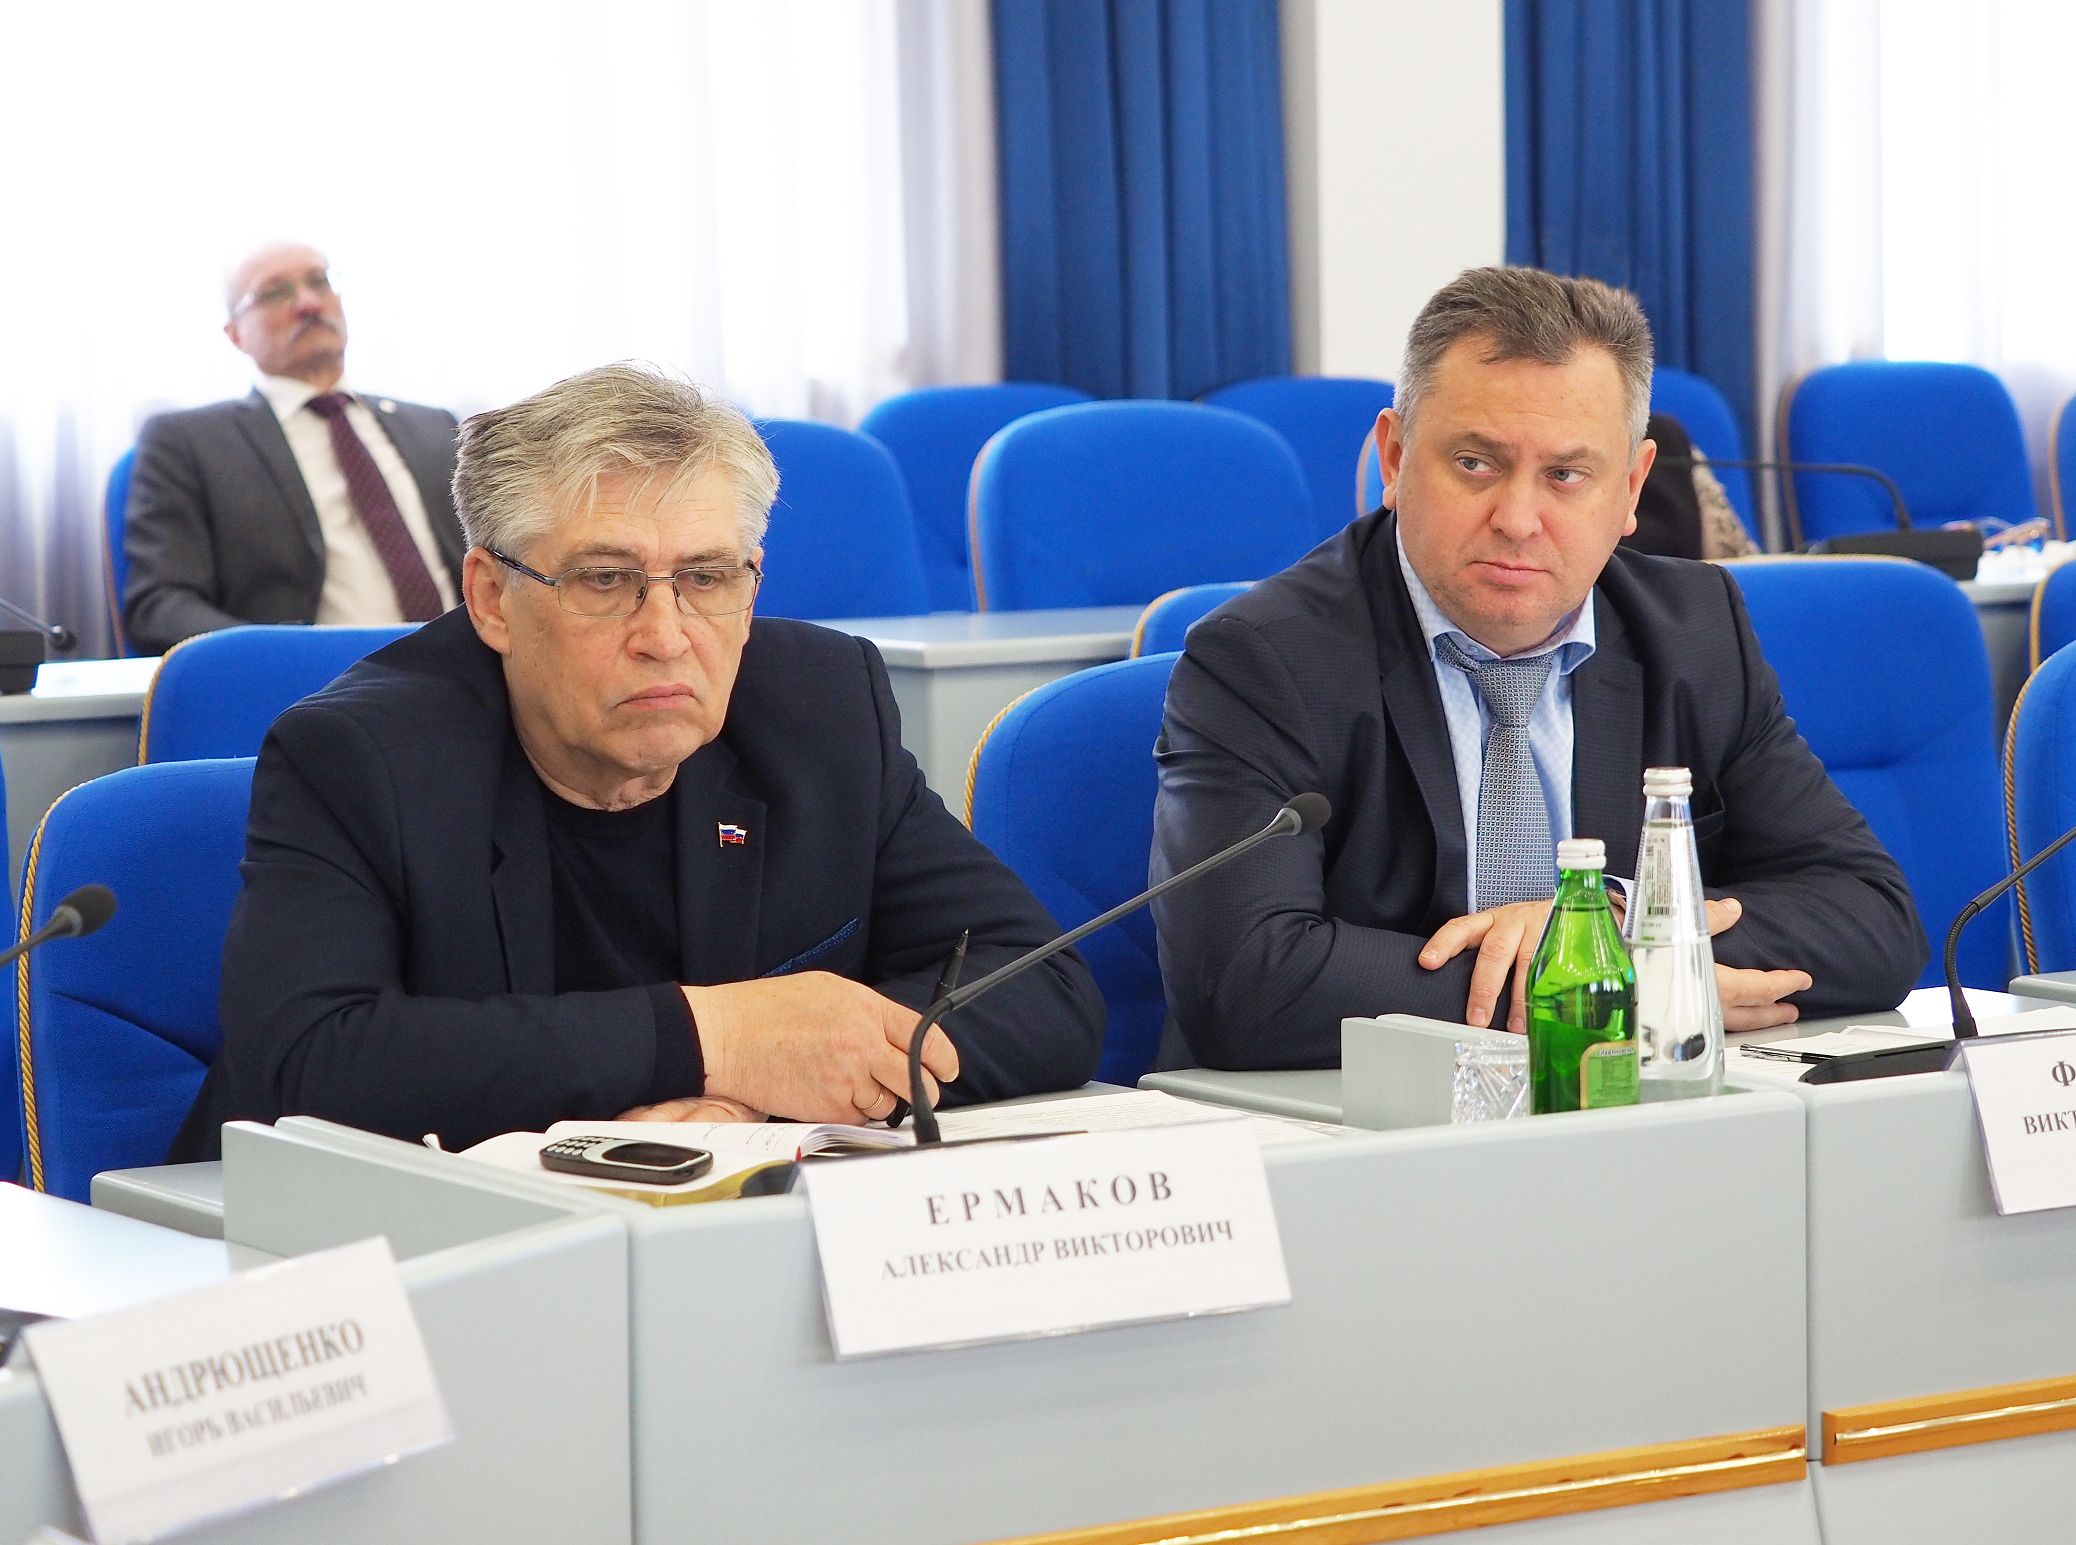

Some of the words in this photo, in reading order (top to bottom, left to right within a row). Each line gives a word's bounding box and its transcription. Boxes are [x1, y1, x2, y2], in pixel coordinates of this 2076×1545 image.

[925, 1170, 1173, 1226] ЕРМАКОВ
[880, 1239, 1046, 1280] АЛЕКСАНДР
[1052, 1219, 1234, 1261] ВИКТОРОВИЧ
[124, 1317, 365, 1417] АНДРЮЩЕНКО
[146, 1416, 223, 1458] ИГОРЬ
[223, 1374, 368, 1432] ВАСИЛЬЕВИЧ
